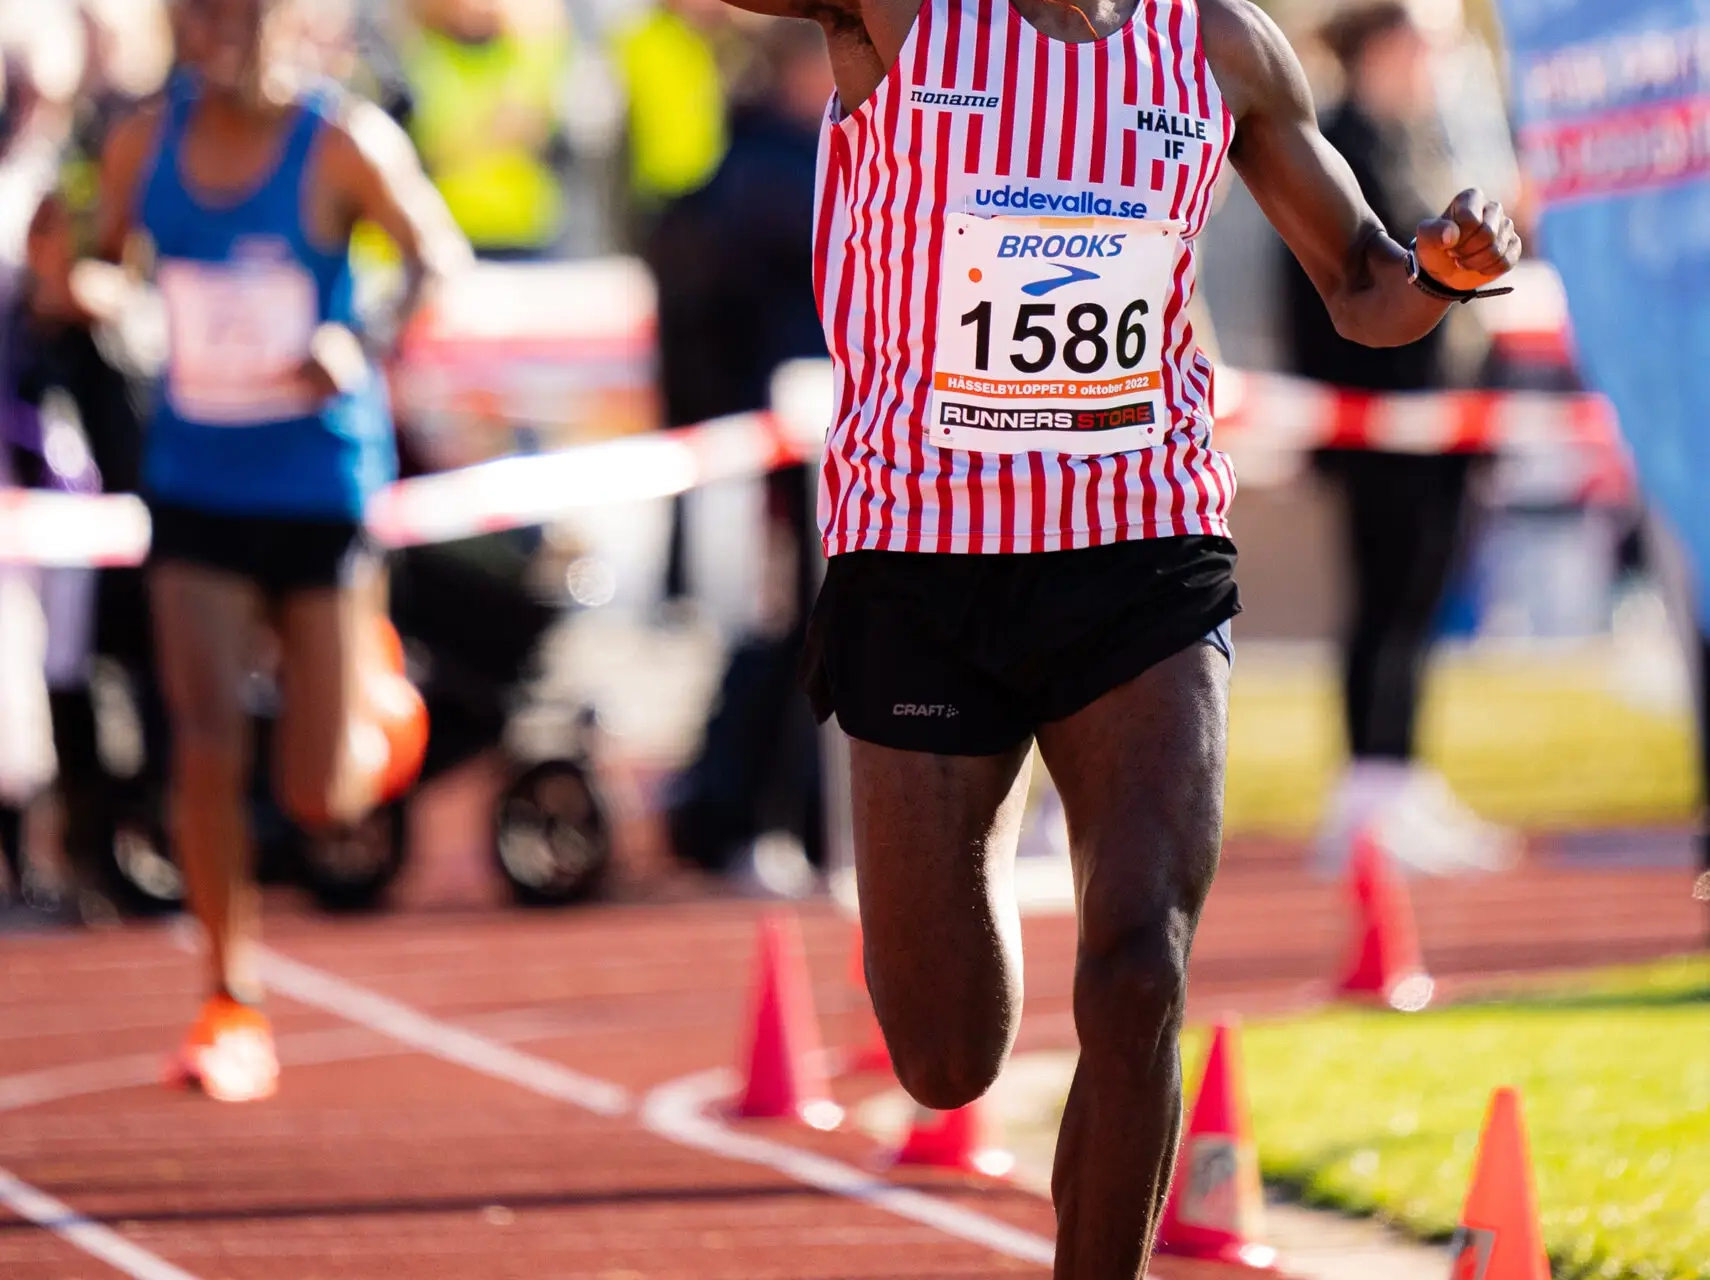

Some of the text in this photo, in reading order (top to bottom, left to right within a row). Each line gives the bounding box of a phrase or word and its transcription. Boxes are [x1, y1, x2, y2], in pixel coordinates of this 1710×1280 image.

[910, 90, 1000, 108] noname
[1137, 107, 1207, 140] HÄLLE
[1164, 138, 1185, 160] IF
[975, 184, 1147, 219] uddevalla.se
[997, 233, 1127, 258] BROOKS
[960, 298, 1149, 374] 1586
[947, 376, 1150, 396] HÄSSELBYLOPPET 9 oktober 2022
[943, 406, 1151, 429] RUNNERS STORE
[892, 703, 945, 717] CRAFT
